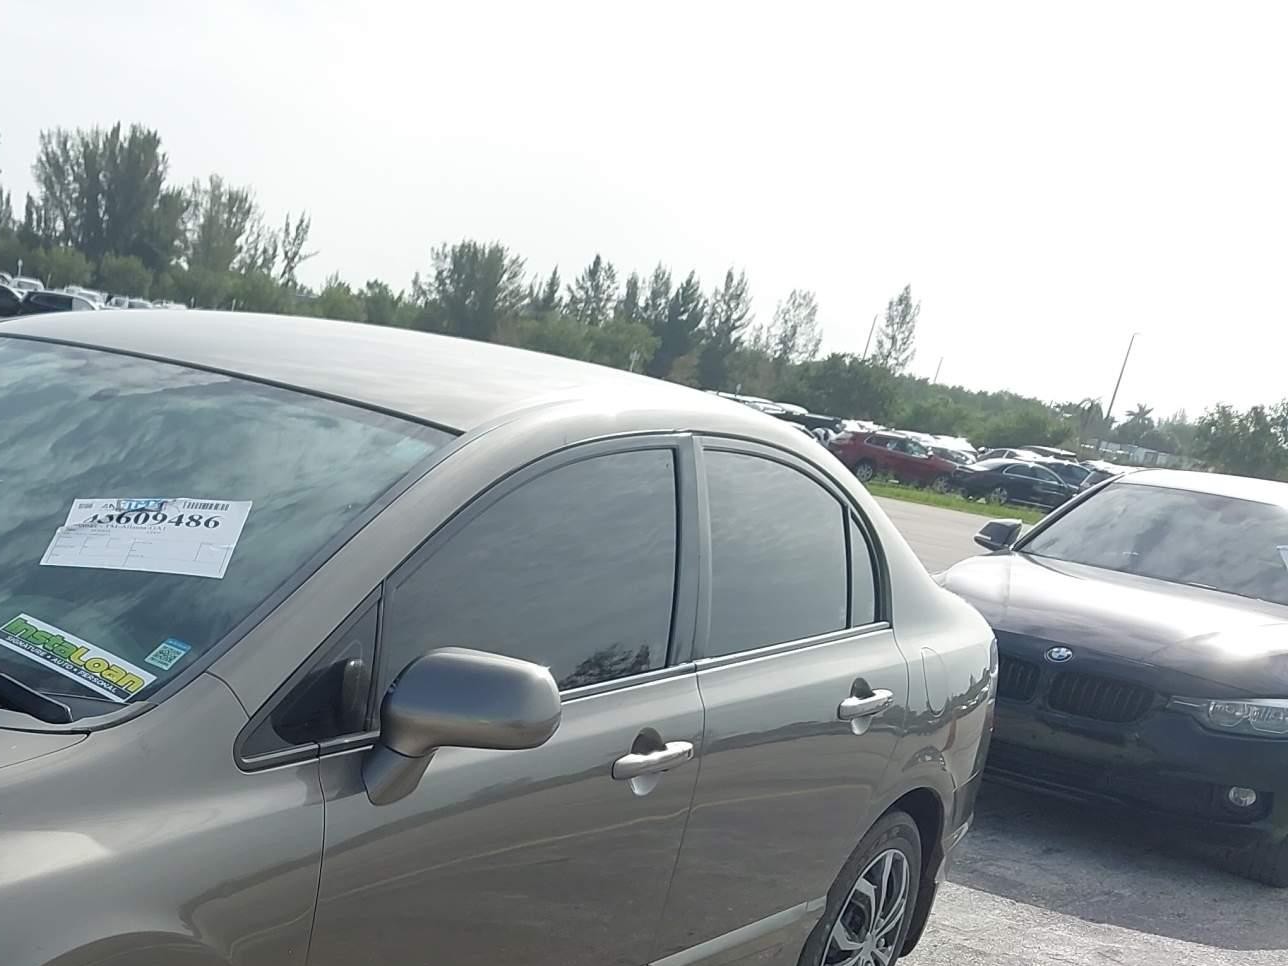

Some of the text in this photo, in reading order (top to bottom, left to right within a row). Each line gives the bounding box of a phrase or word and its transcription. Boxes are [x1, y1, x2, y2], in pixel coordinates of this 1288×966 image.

[2, 617, 145, 693] InstaLoan
[6, 635, 118, 694] SIGNATURE AUTO PERSONAL
